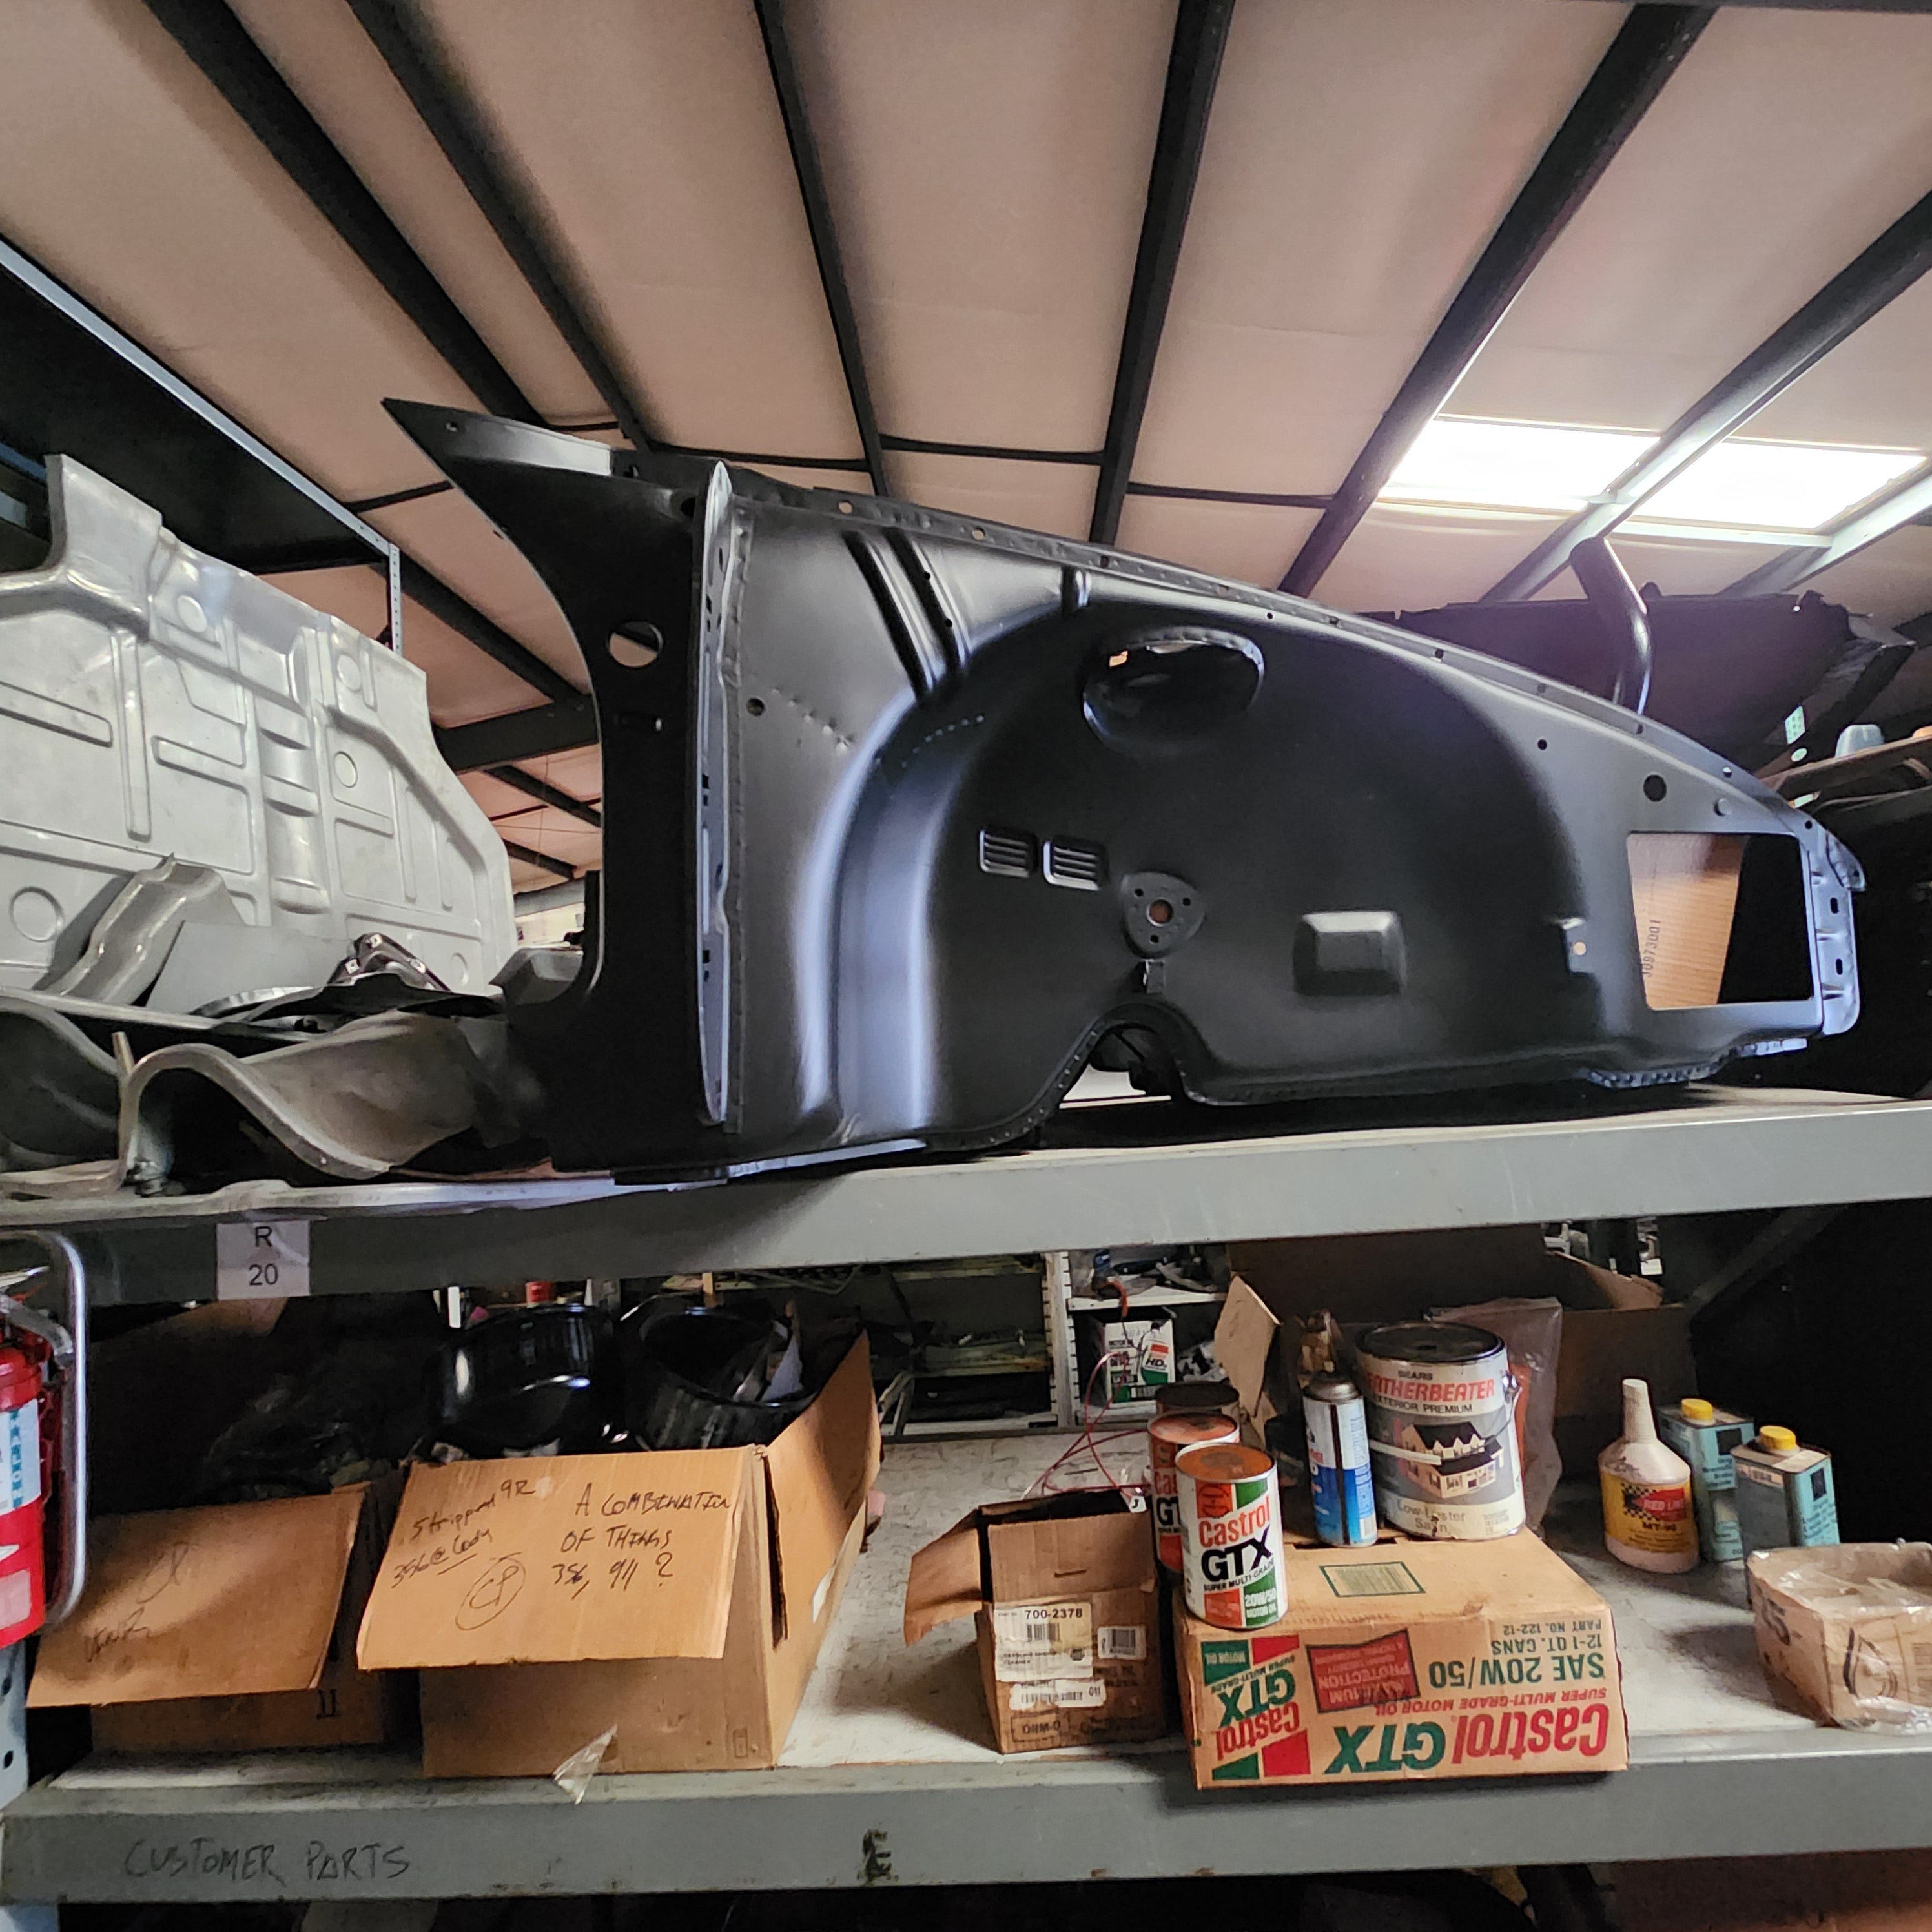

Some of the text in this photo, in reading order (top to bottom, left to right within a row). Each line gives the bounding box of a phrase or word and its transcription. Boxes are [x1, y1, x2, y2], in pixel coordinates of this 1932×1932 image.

[255, 1226, 272, 1247] R
[249, 1263, 278, 1286] 20
[1368, 1372, 1495, 1403] ATHERBEATER
[1398, 1370, 1433, 1381] SEARS
[1423, 1403, 1473, 1414] PREMIUM
[575, 1482, 593, 1516] A
[1156, 1495, 1181, 1526] GT
[1198, 1495, 1271, 1548] Castrol
[1415, 1517, 1448, 1532] San
[560, 1528, 596, 1552] OF
[1200, 1523, 1273, 1582] GTX
[609, 1558, 639, 1592] 911
[655, 1551, 673, 1587] ?
[1025, 1607, 1083, 1620] 700-2378
[1503, 1619, 1601, 1636] PART NO. 122-12
[1218, 1651, 1246, 1664] MOTOR
[1491, 1634, 1602, 1655] 12-1 QT. CANS
[1317, 1660, 1410, 1690] PROTECTION
[1428, 1656, 1542, 1689] 20W/50
[1552, 1652, 1605, 1681] SAE
[1217, 1668, 1296, 1729] GTX
[1374, 1687, 1607, 1717] SUPER MULTI-GRADE MOTOR OIL
[1215, 1701, 1300, 1761] Castrol
[1324, 1703, 1609, 1775] Castrol GTX
[124, 1836, 410, 1888] CUSTOMER PARTS
